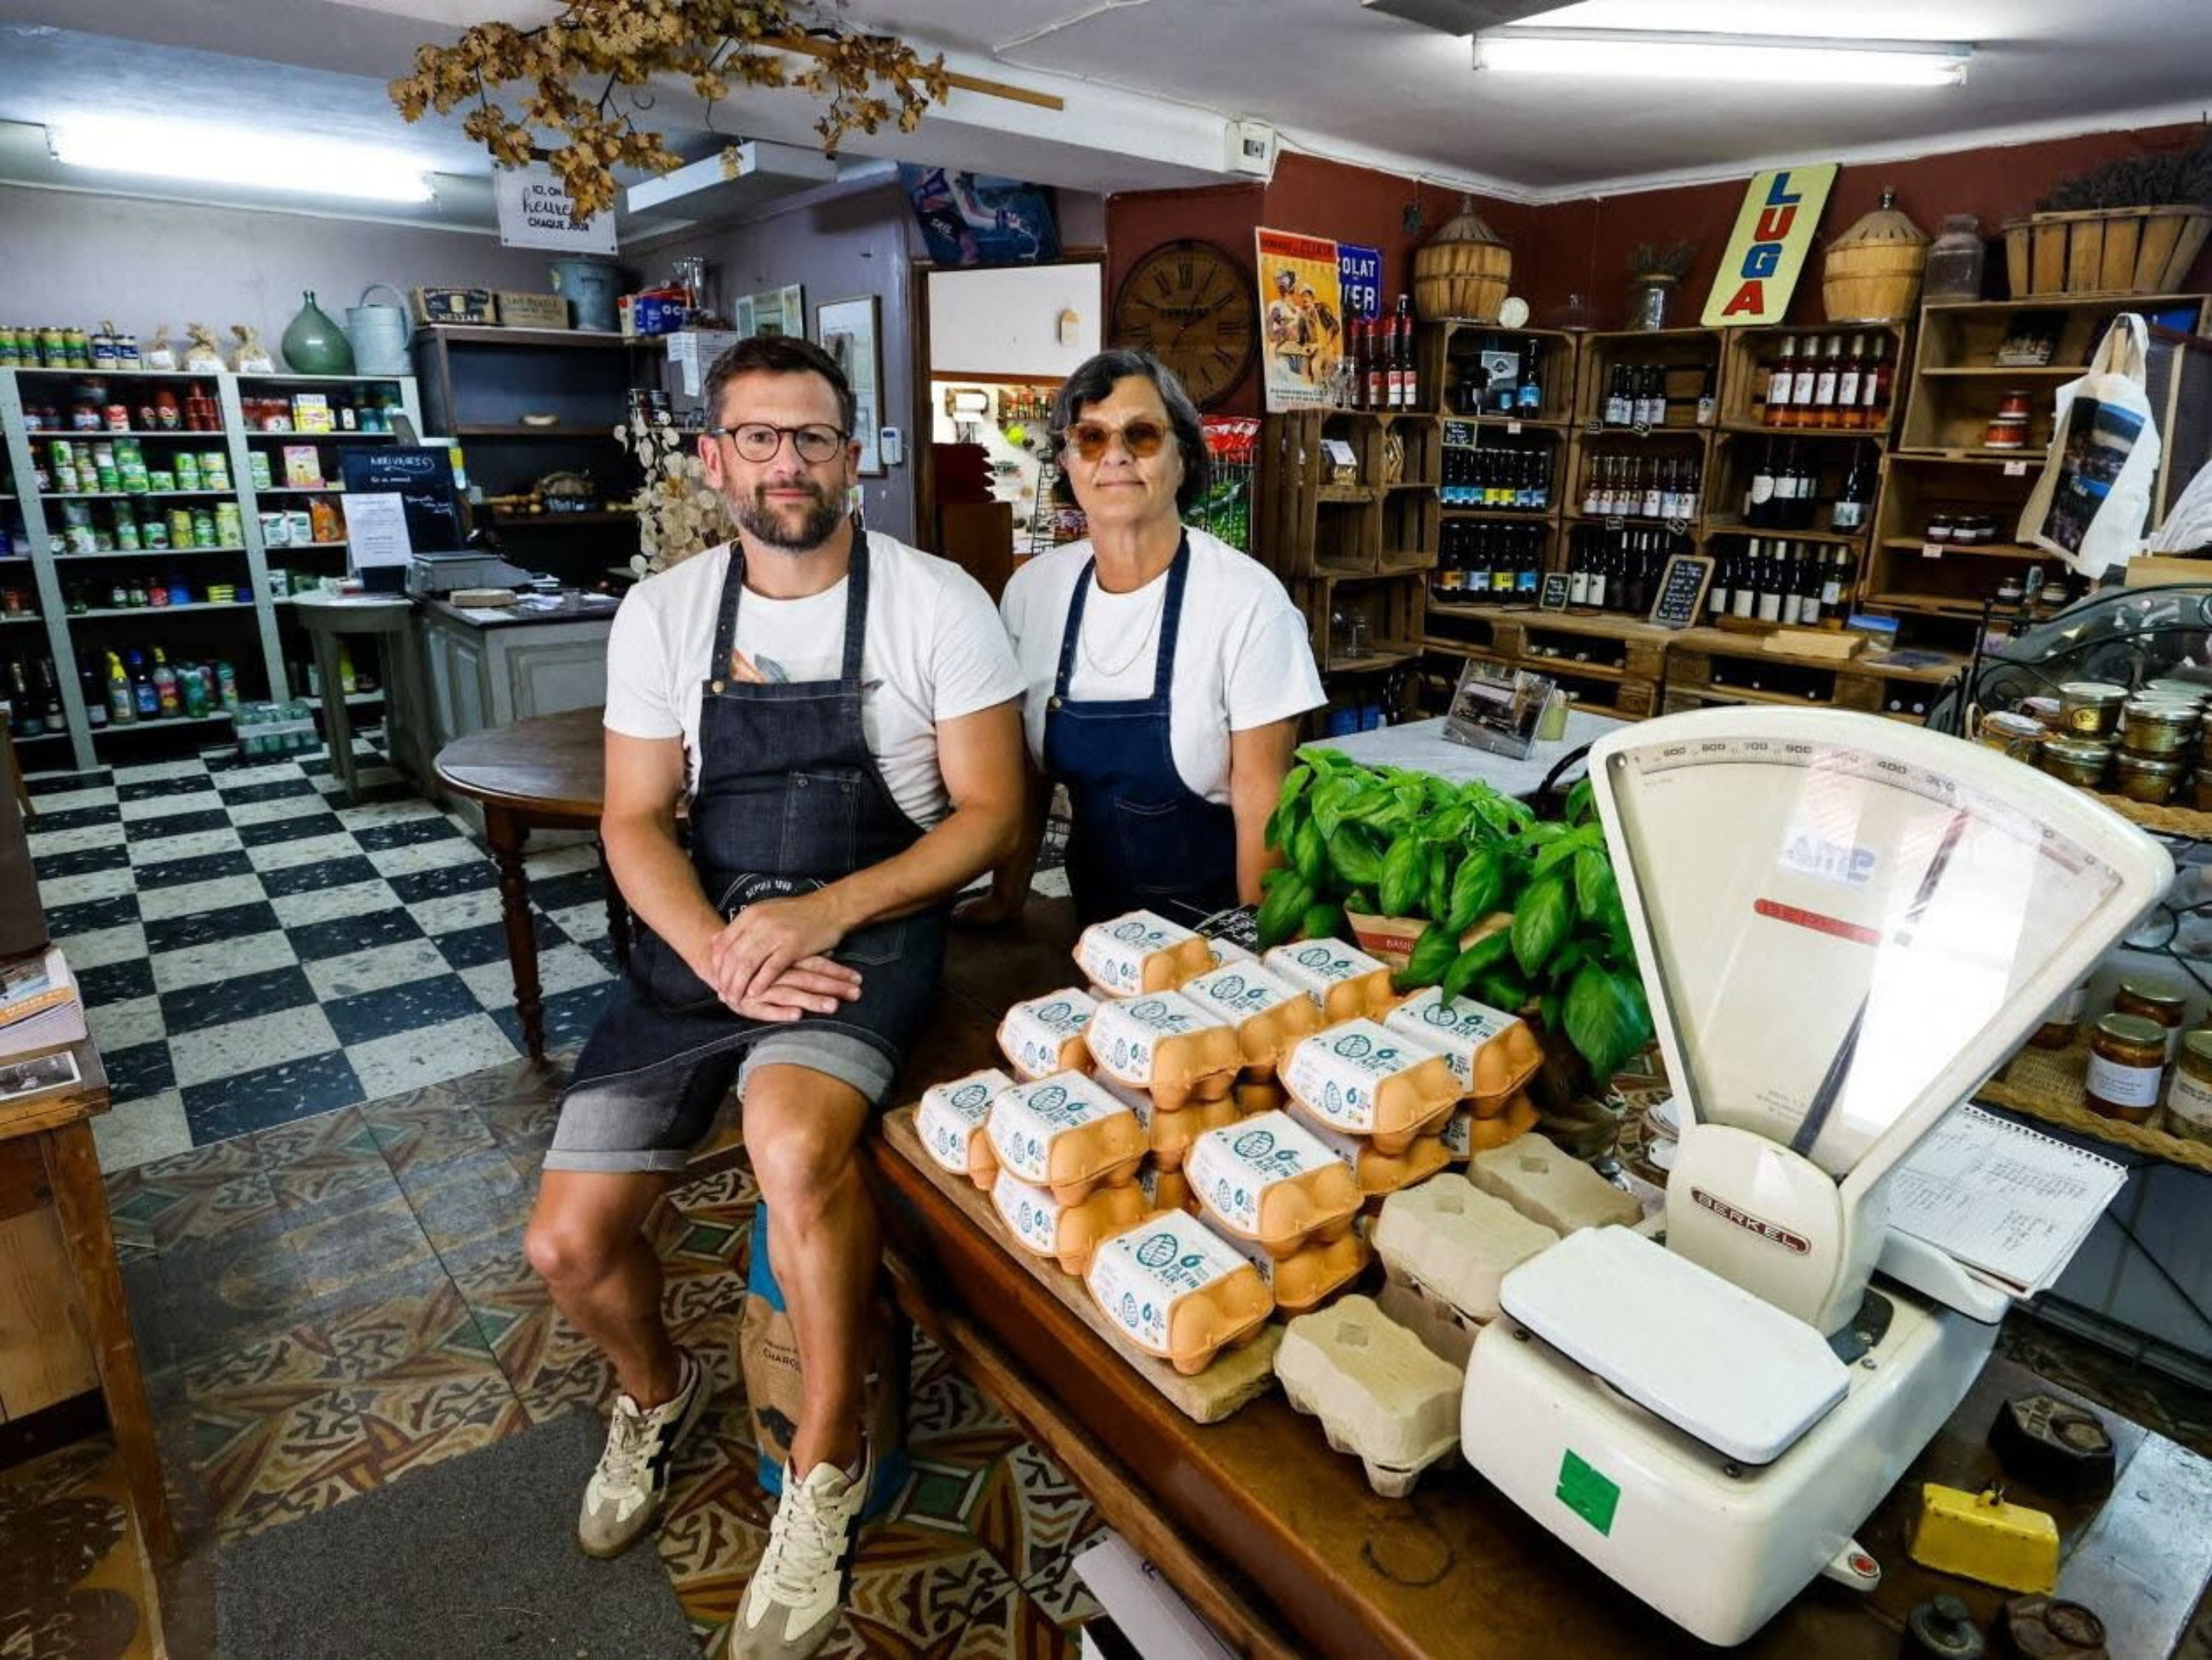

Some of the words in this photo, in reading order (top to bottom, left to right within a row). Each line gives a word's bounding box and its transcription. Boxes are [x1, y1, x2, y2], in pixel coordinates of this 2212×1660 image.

[522, 187, 572, 216] heure
[528, 217, 564, 230] CHAQUE
[1720, 171, 1803, 316] LUGA
[1337, 256, 1376, 279] OLAT
[1877, 761, 1908, 774] 400
[1697, 1192, 1799, 1251] BERKEL
[1180, 1255, 1206, 1269] 6
[1143, 1302, 1152, 1321] 6
